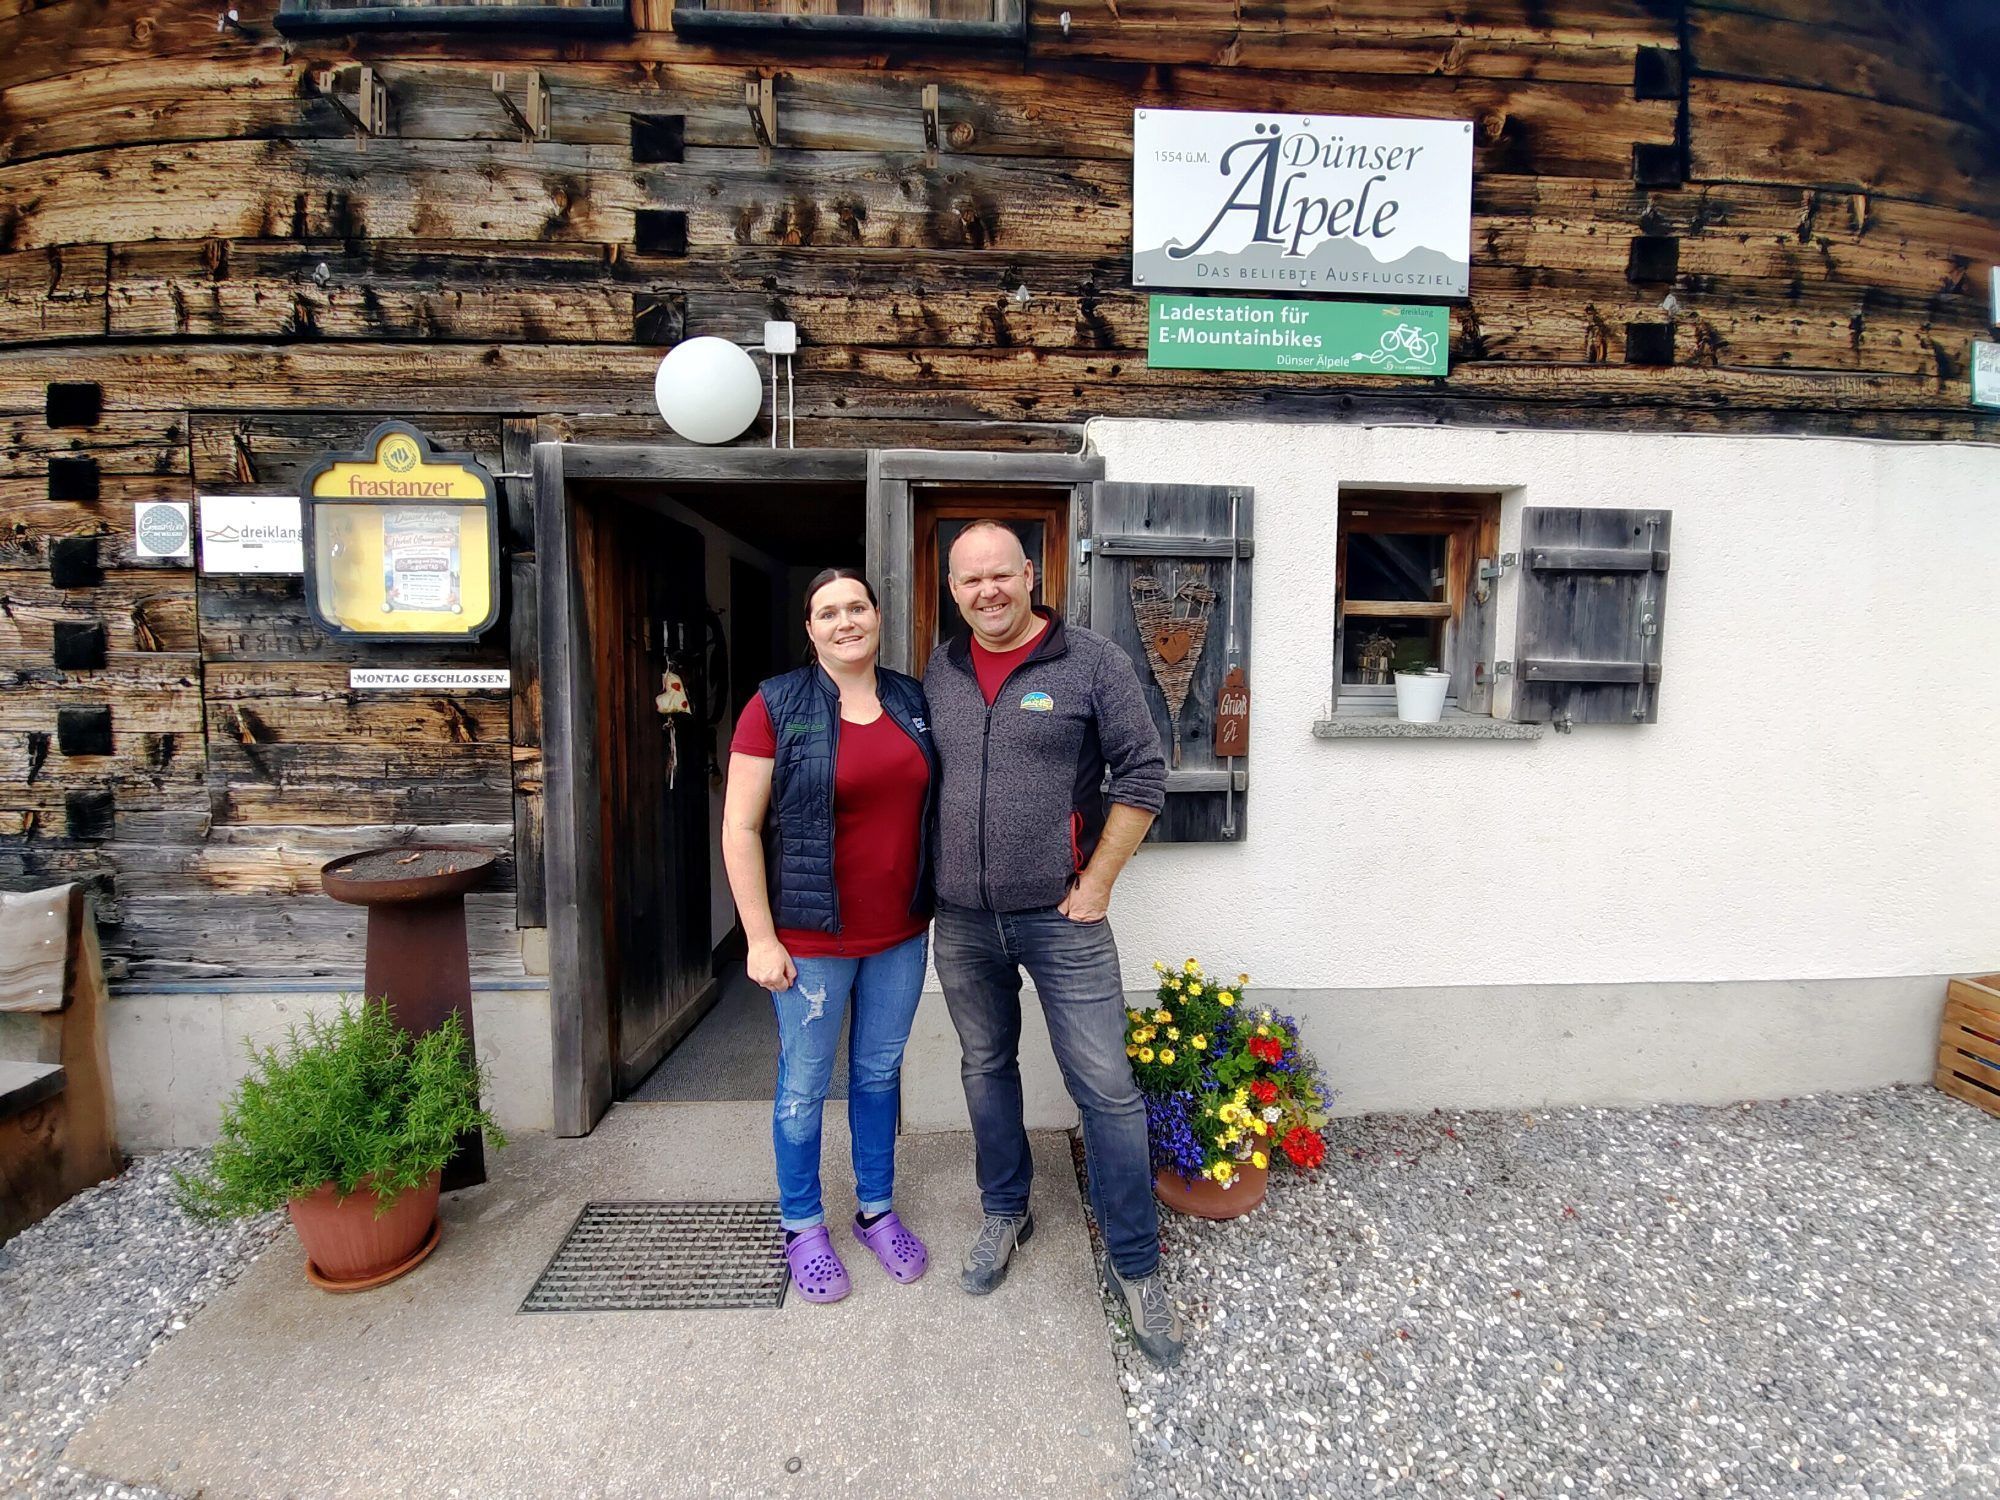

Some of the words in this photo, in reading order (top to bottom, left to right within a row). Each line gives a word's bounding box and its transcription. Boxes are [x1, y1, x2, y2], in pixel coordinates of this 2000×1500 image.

[1155, 150, 1182, 163] 1554
[1283, 133, 1425, 171] Dünser
[1168, 123, 1399, 259] Älpele
[1197, 263, 1230, 279] DAS
[1326, 267, 1454, 286] AUSFLUGSZIEL
[1159, 303, 1275, 324] Ladestation
[1280, 304, 1310, 325] für
[1400, 307, 1434, 318] dreiklang
[1158, 326, 1323, 348] E-Mountainbikes
[1276, 354, 1314, 367] Dünser
[1316, 352, 1350, 370] Älpele
[347, 474, 455, 497] frastanzer
[241, 524, 304, 542] dreiklang
[355, 674, 409, 684] MONTAG
[413, 674, 505, 684] GESCHLOSSEN
